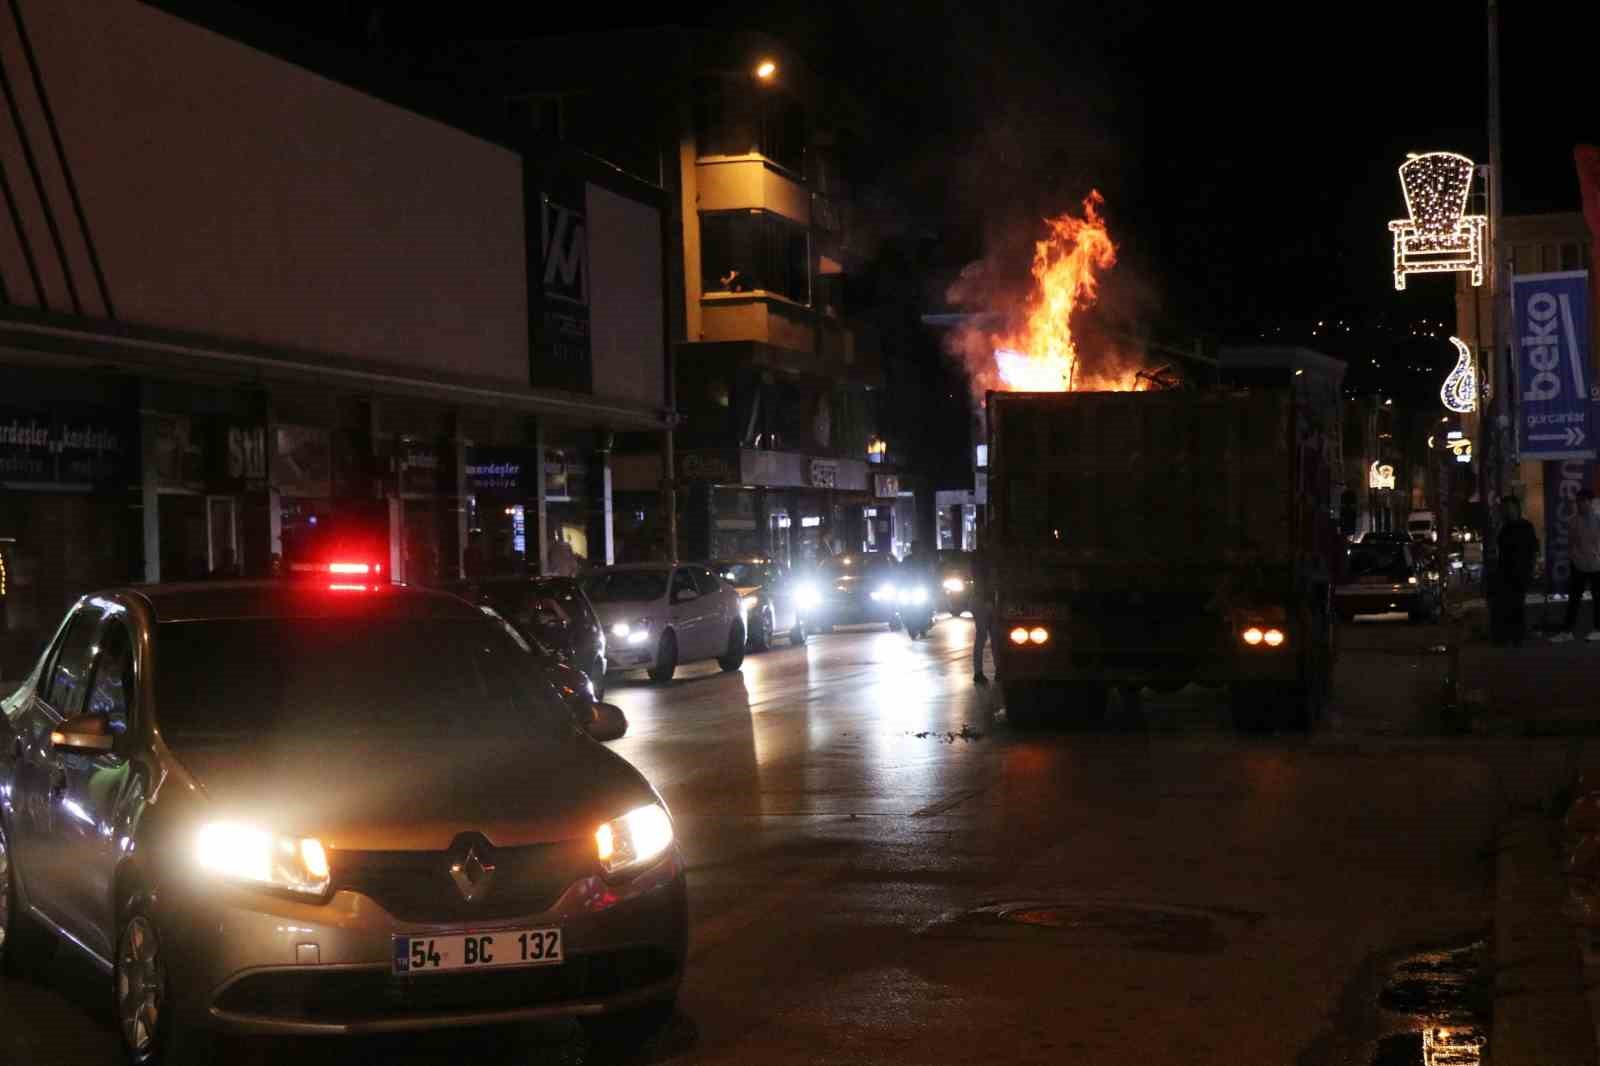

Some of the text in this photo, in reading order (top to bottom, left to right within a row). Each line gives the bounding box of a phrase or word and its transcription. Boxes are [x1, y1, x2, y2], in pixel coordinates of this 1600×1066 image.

[1521, 291, 1561, 400] beko
[411, 939, 441, 968] 54
[464, 935, 494, 965] BC
[518, 931, 559, 961] 132
